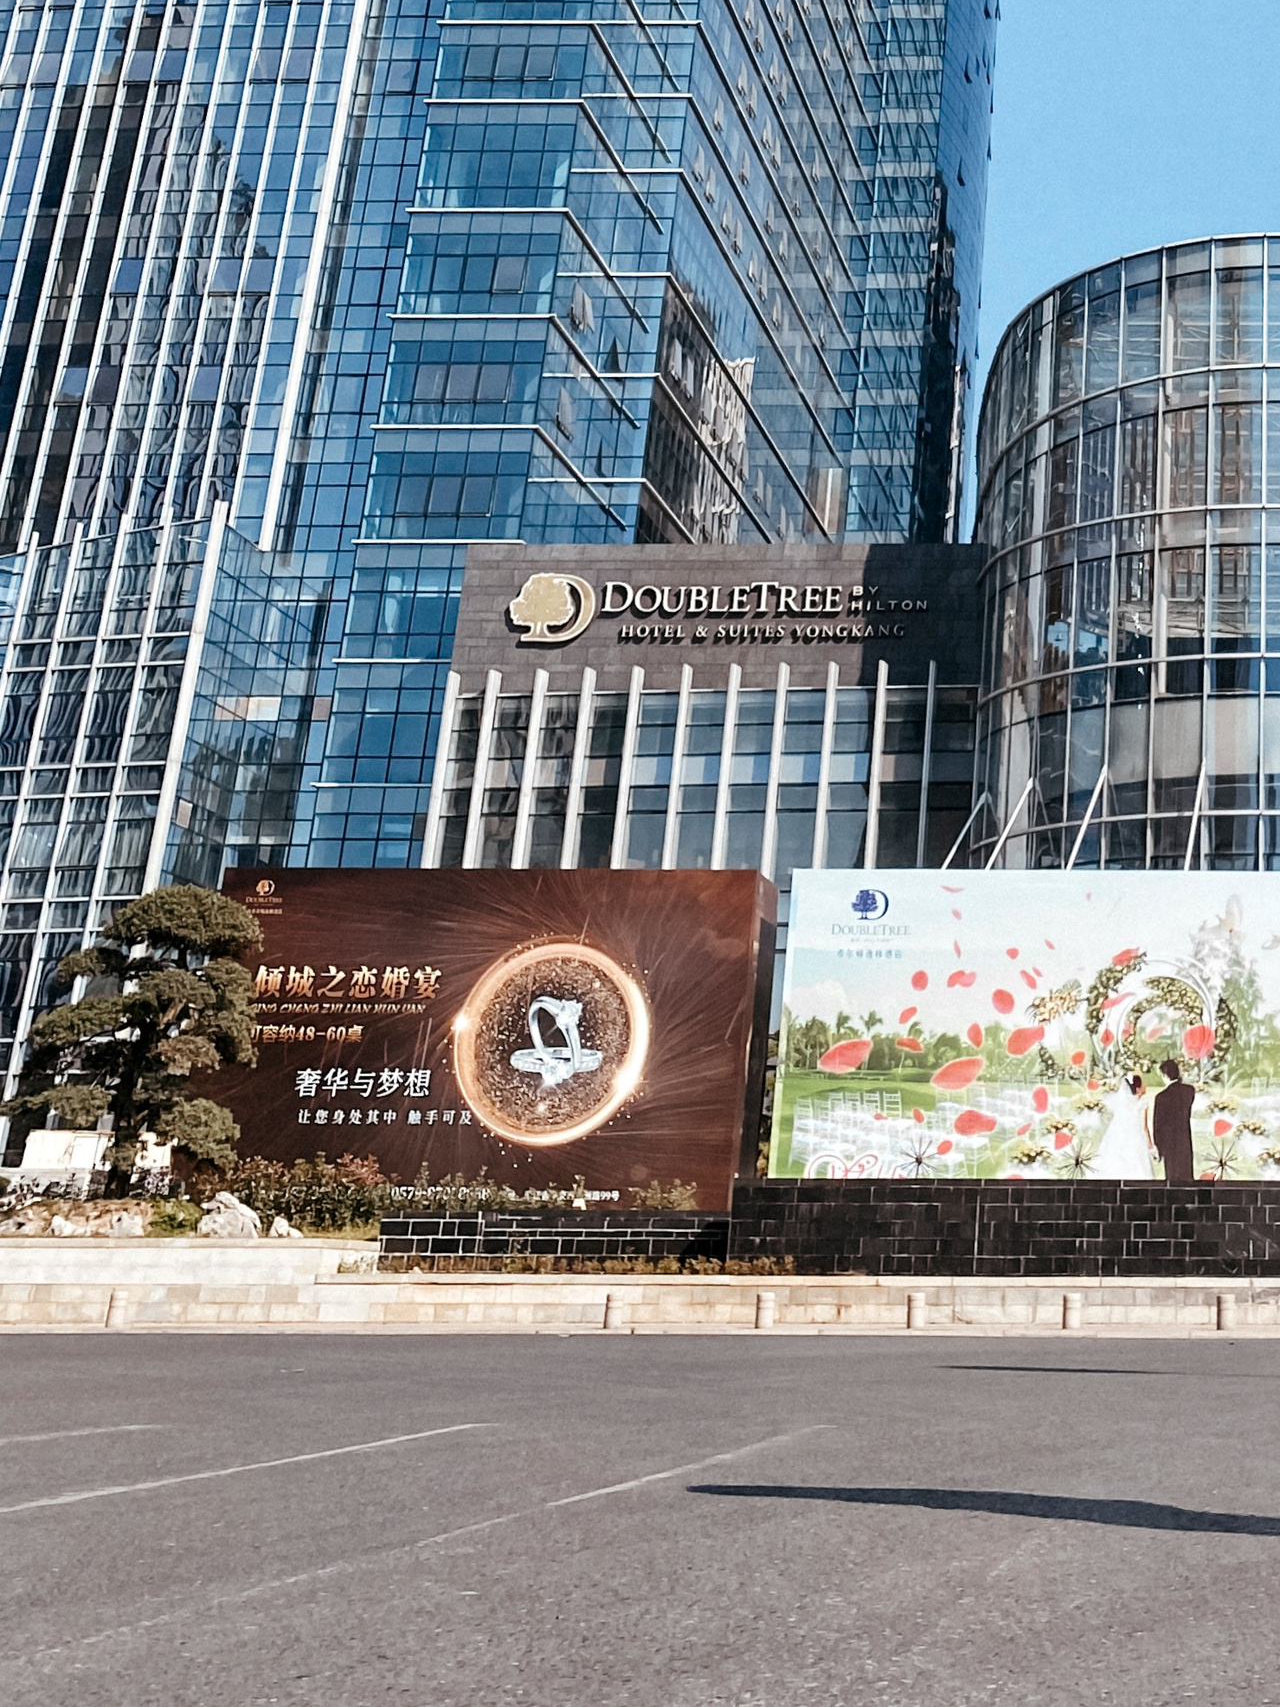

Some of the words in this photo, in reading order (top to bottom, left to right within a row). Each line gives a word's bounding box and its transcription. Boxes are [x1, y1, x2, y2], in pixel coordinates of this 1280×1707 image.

[601, 581, 843, 614] DOUBLETREE
[853, 586, 878, 597] BY
[851, 599, 928, 611] HILTON
[621, 624, 686, 638] HOTEL
[696, 624, 708, 638] &
[717, 624, 786, 638] SUITES
[795, 623, 906, 638] YONGKANG
[831, 923, 912, 935] DOUBLETREE
[254, 965, 442, 999] 倾城之恋婚宴
[295, 1068, 431, 1098] 奢华与梦想
[298, 1109, 398, 1126] 让您身处其中
[407, 1109, 473, 1126] 触手可及
